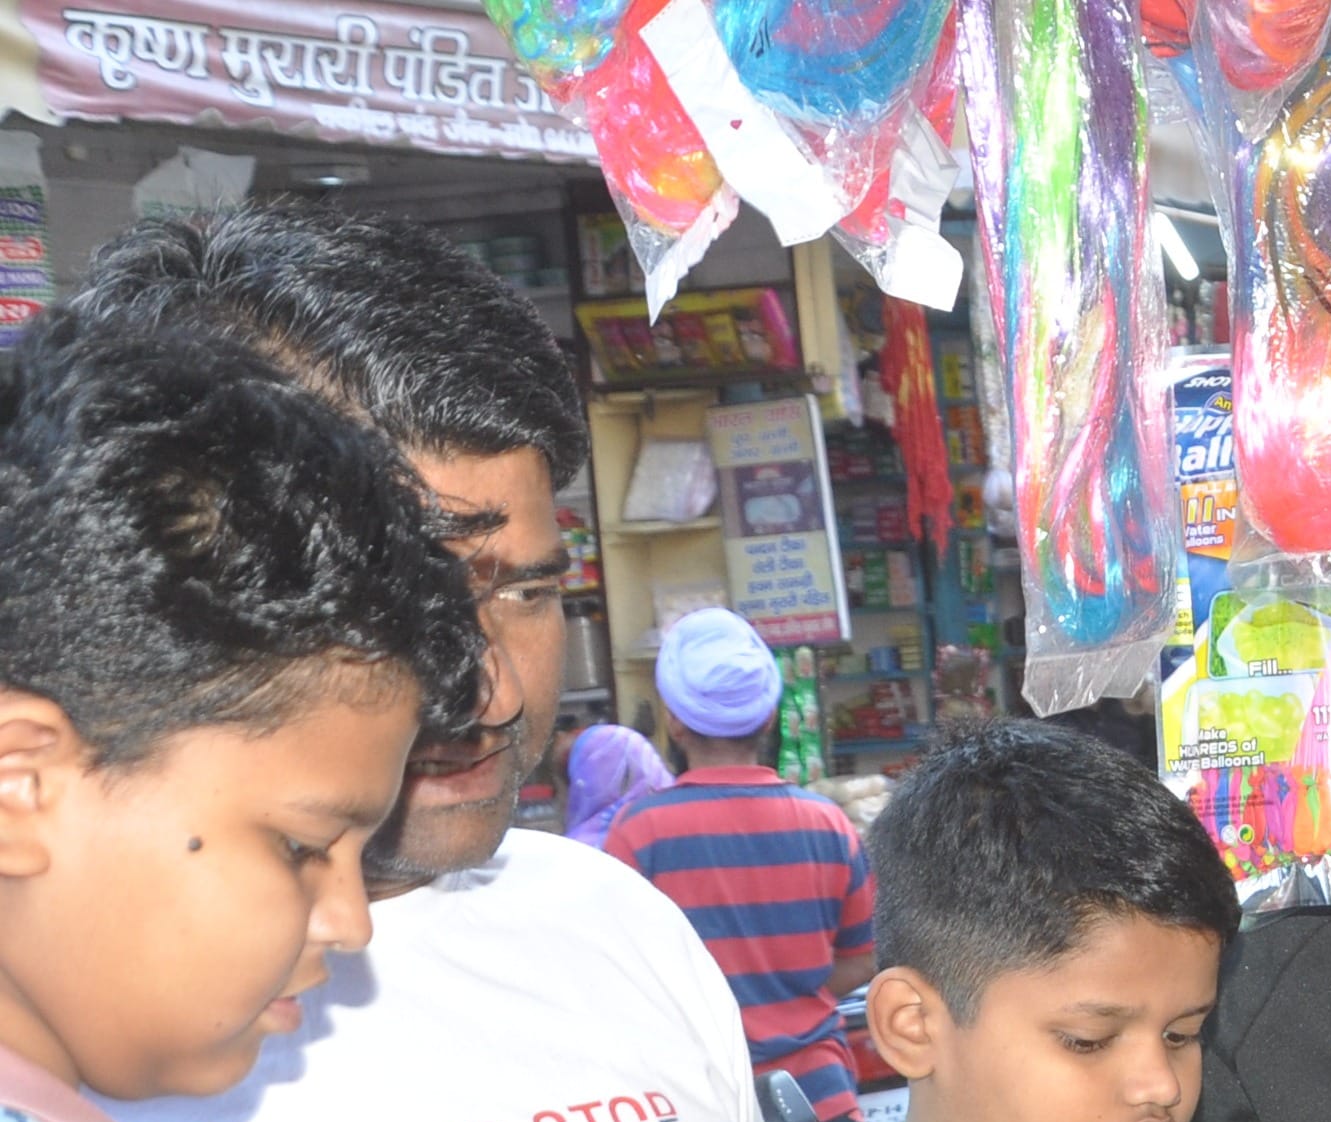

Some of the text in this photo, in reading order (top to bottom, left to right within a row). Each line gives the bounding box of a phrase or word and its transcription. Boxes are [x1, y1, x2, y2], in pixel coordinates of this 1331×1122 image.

[63, 8, 211, 91] कृष्ण
[220, 15, 378, 106] मुरारी
[382, 27, 508, 106] पंडित
